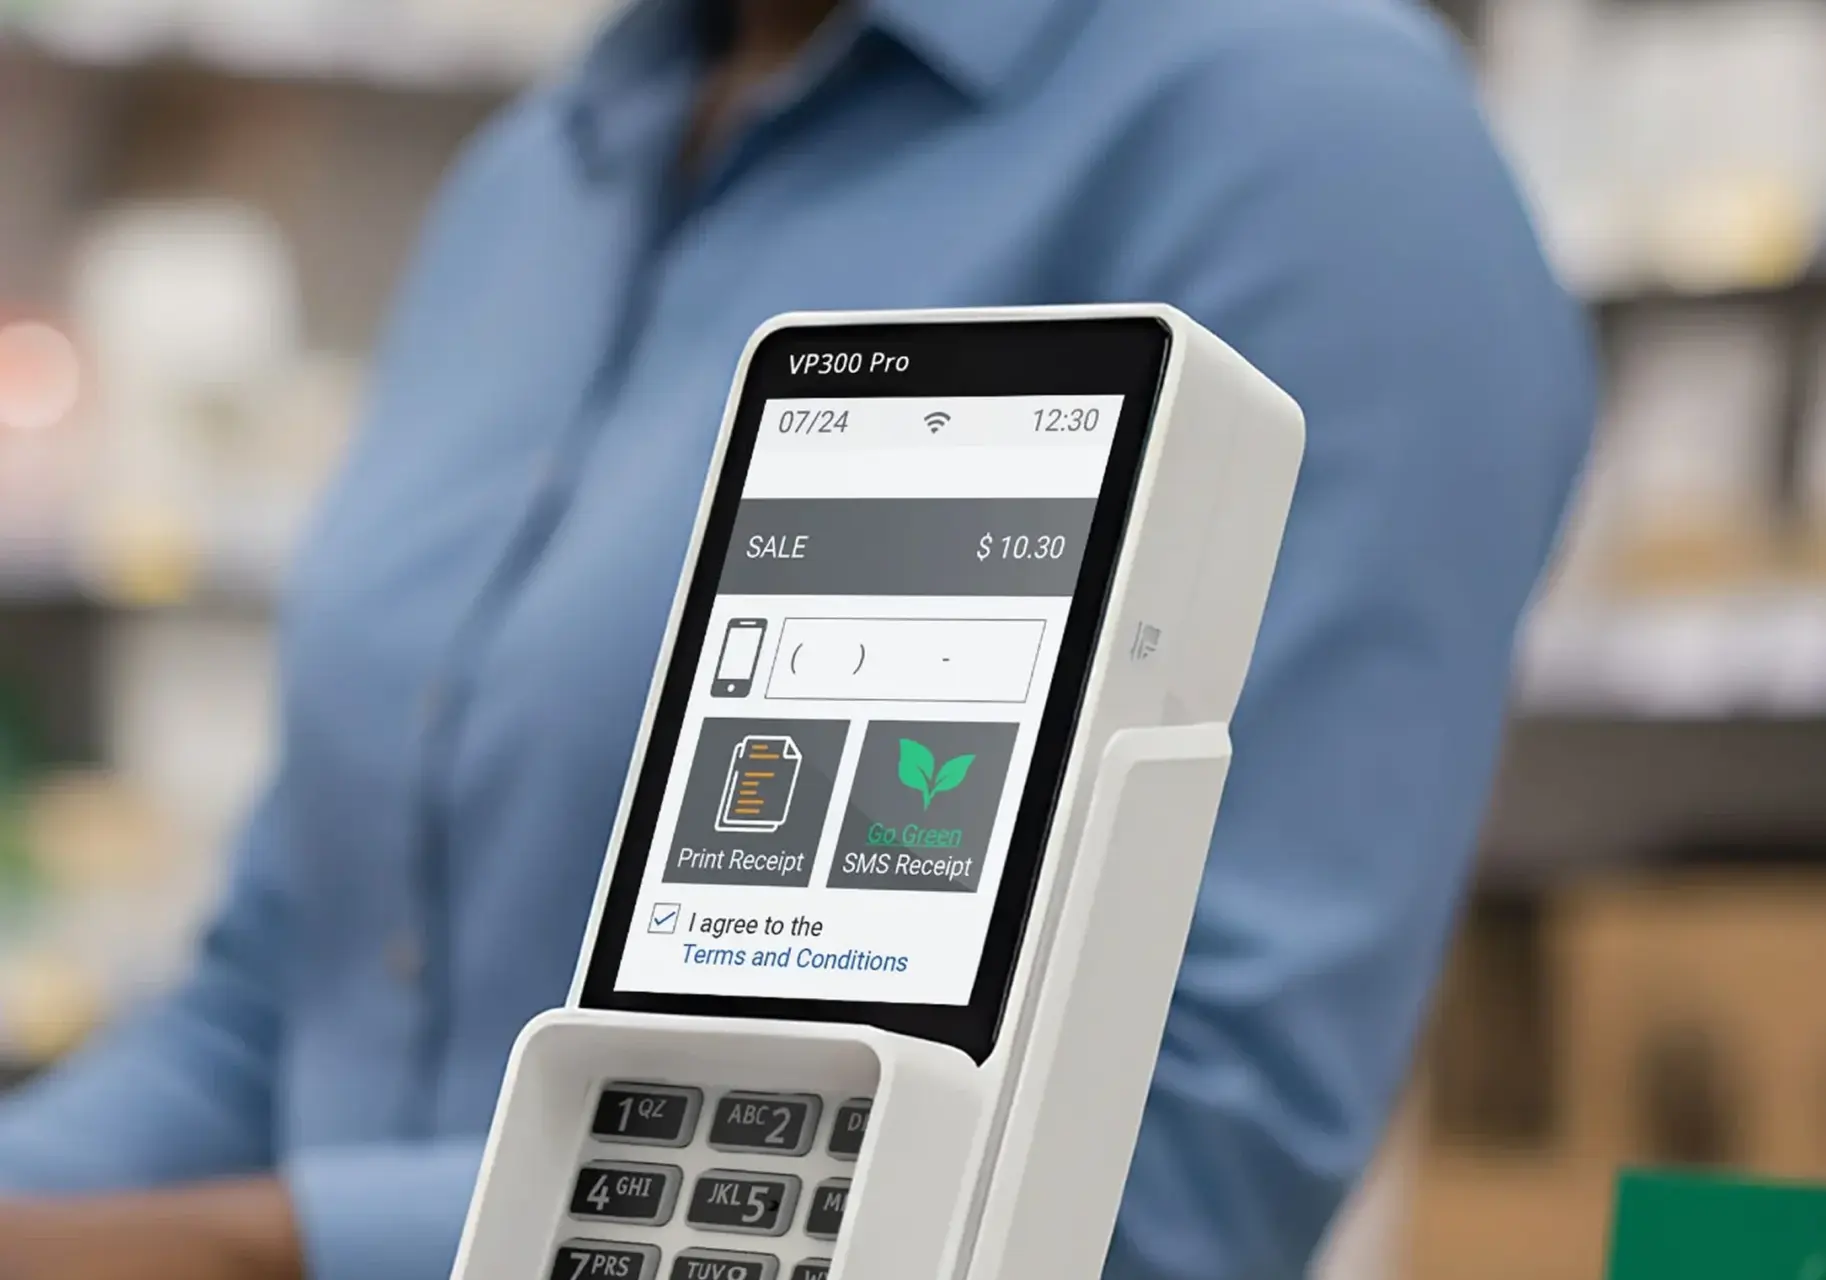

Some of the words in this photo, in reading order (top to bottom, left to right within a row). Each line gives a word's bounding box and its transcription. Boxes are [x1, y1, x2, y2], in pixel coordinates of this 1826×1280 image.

[789, 352, 863, 375] VP300
[869, 351, 910, 373] Pro
[778, 410, 850, 435] 07/24
[1032, 407, 1100, 433] 12:30
[745, 535, 809, 559] SALE
[1001, 535, 1066, 560] 10.30
[866, 823, 896, 844] Go
[902, 824, 963, 847] Green
[677, 848, 724, 870] Print
[729, 849, 805, 876] Receipt
[842, 853, 890, 875] SMS
[895, 854, 972, 882] Receipt
[688, 912, 697, 933] I
[700, 917, 758, 938] agree
[764, 915, 784, 936] to
[791, 916, 823, 937] the
[683, 944, 746, 967] Terms
[751, 948, 791, 969] and
[796, 948, 909, 973] Conditions
